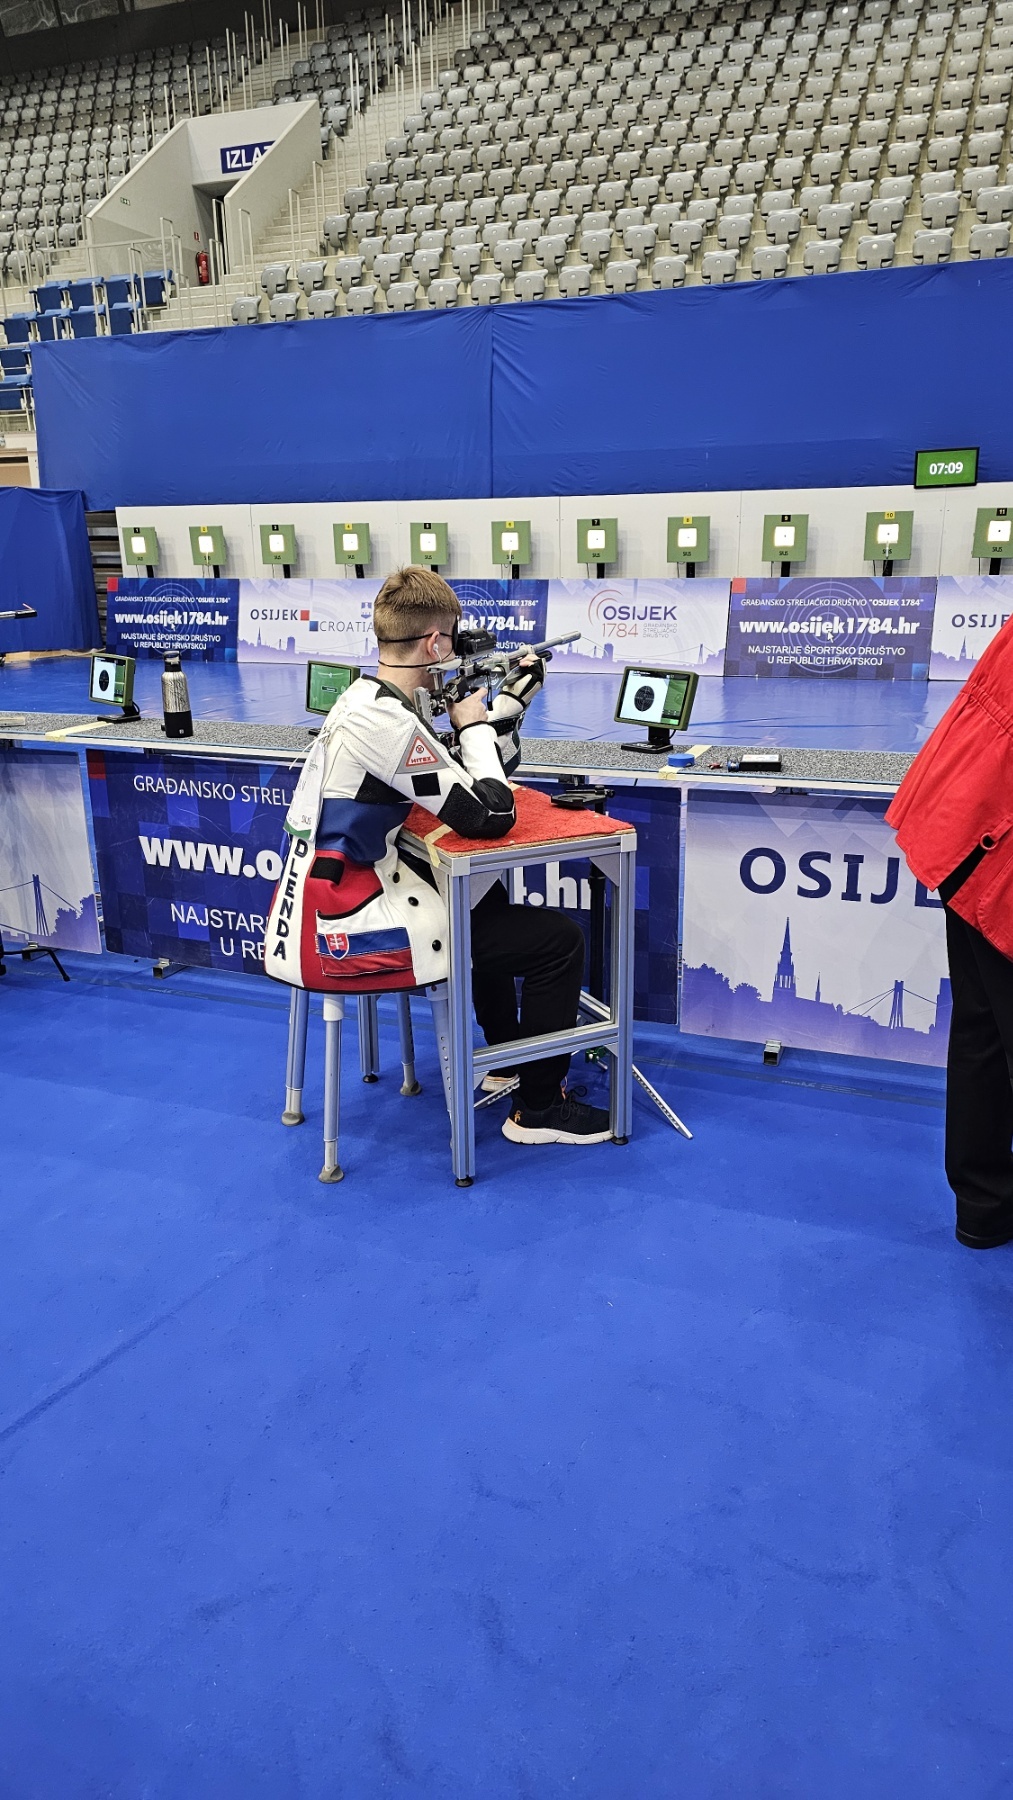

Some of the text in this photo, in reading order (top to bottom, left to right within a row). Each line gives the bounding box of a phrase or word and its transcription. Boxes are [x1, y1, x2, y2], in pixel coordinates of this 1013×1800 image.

[226, 145, 272, 169] IZLA
[929, 461, 964, 475] 07:09
[468, 598, 495, 606] DRUŠTVO
[521, 599, 539, 607] 1784"
[741, 597, 924, 606] GRAĐANSKO STRELJAČKO DRUŠTVO "OSIJEK 1784"
[114, 610, 229, 627] www.osijek1784.hr
[250, 608, 299, 621] OSIJEK
[603, 605, 678, 620] OSIJEK
[319, 621, 375, 632] CROATIA
[602, 623, 639, 638] 1784
[739, 616, 920, 637] www.osijek1784.hr
[121, 631, 221, 643] NAJSTARIJE ŠPORTSKO DRUŠTVO
[139, 641, 171, 649] REPUBLICI
[172, 642, 207, 650] HRVATSKOJ
[748, 644, 906, 656] NAJSTARIJE ŠPORTSKO DRUŠTVO
[767, 655, 883, 666] U REPUBLICI HRVATSKOJ
[133, 775, 236, 800] GRAĐANSKO
[138, 835, 284, 881] www.o
[220, 937, 234, 956] U
